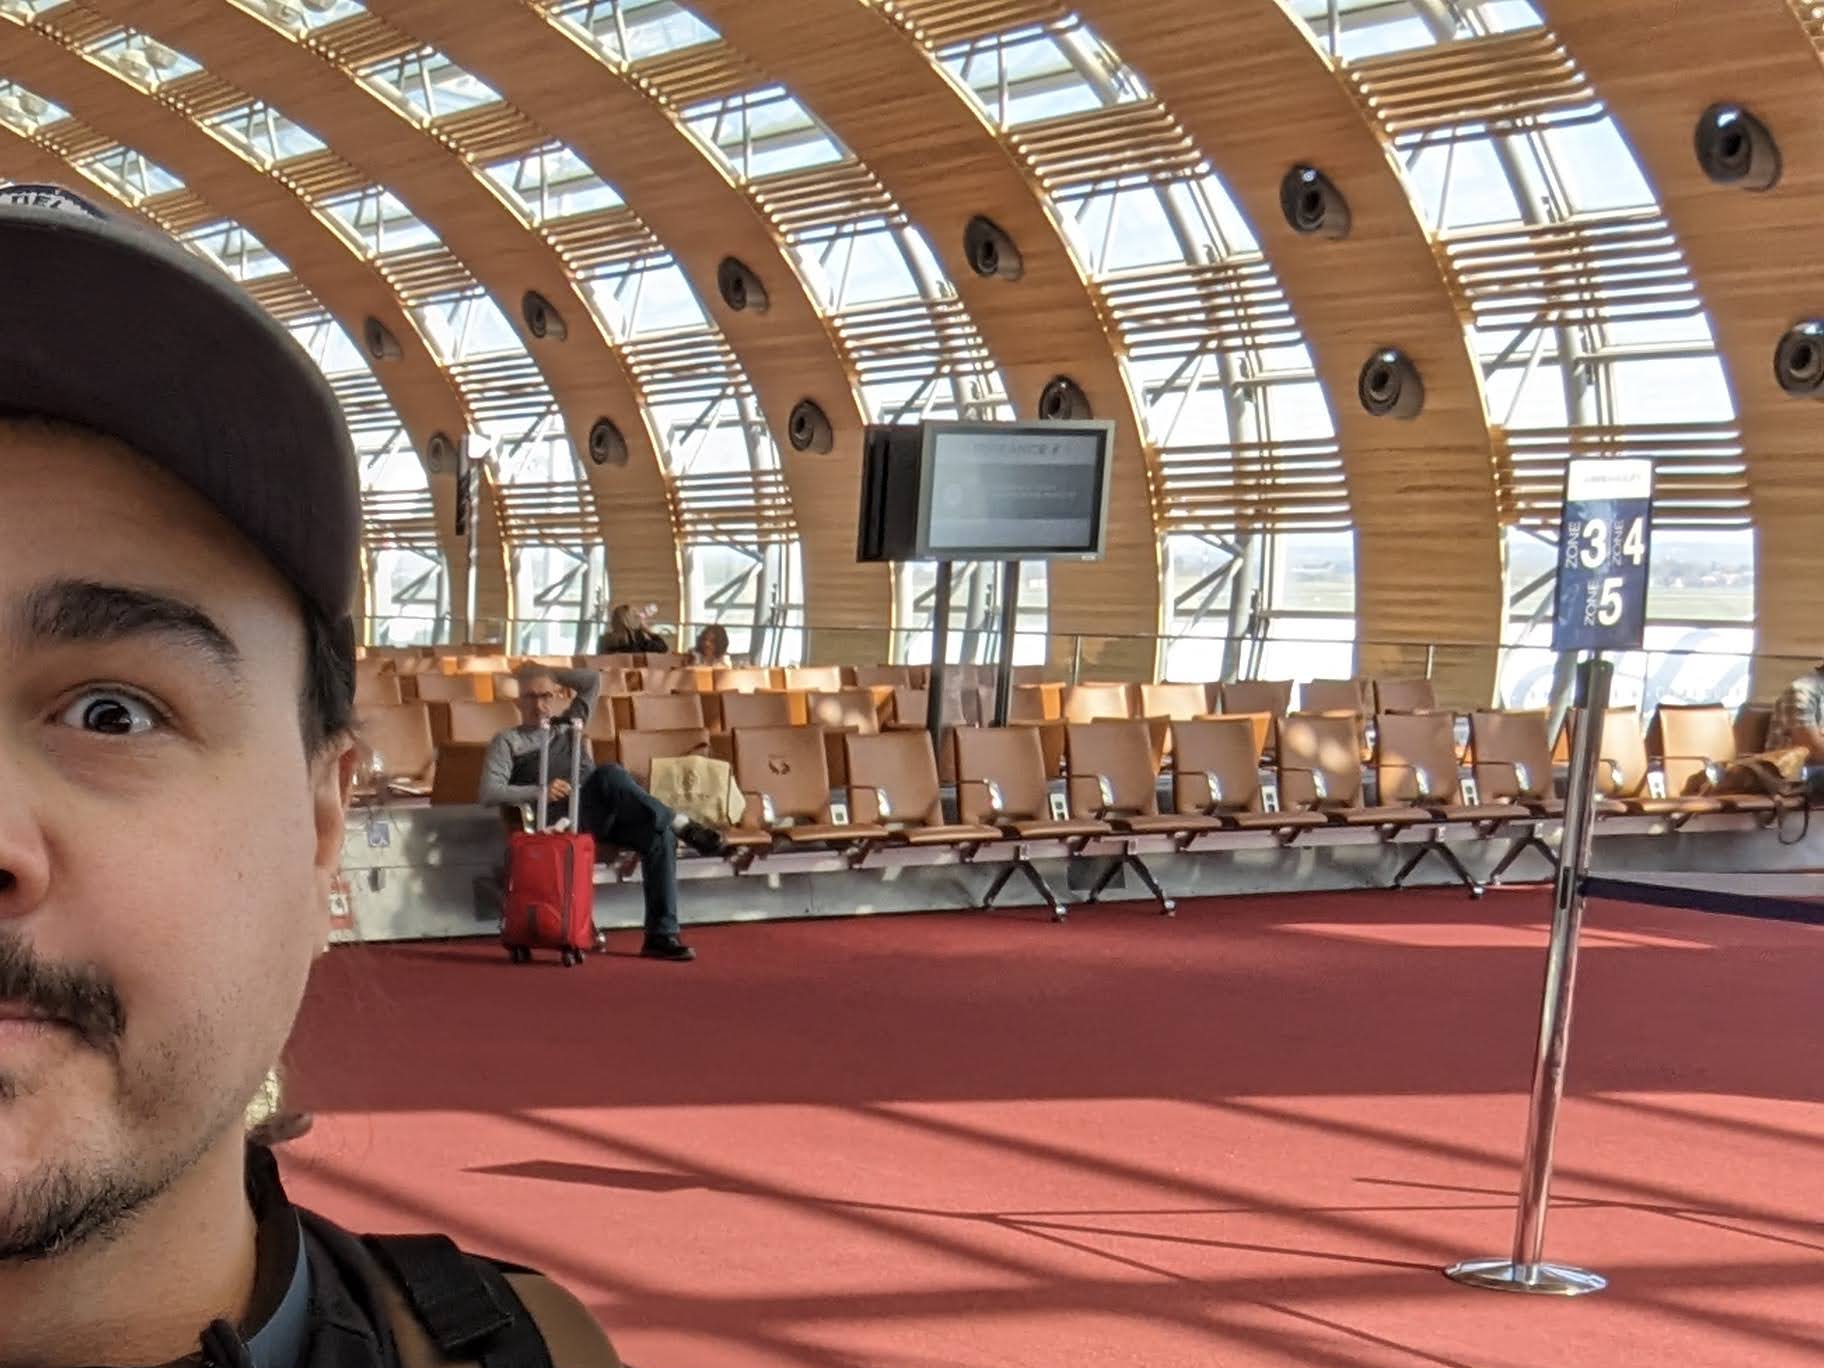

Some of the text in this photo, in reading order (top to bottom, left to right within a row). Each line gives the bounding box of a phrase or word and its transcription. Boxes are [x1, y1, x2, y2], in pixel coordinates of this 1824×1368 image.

[1565, 518, 1607, 569] ZONE 3
[1612, 516, 1645, 567] ZONE 4
[1584, 576, 1624, 627] ZONE 5
